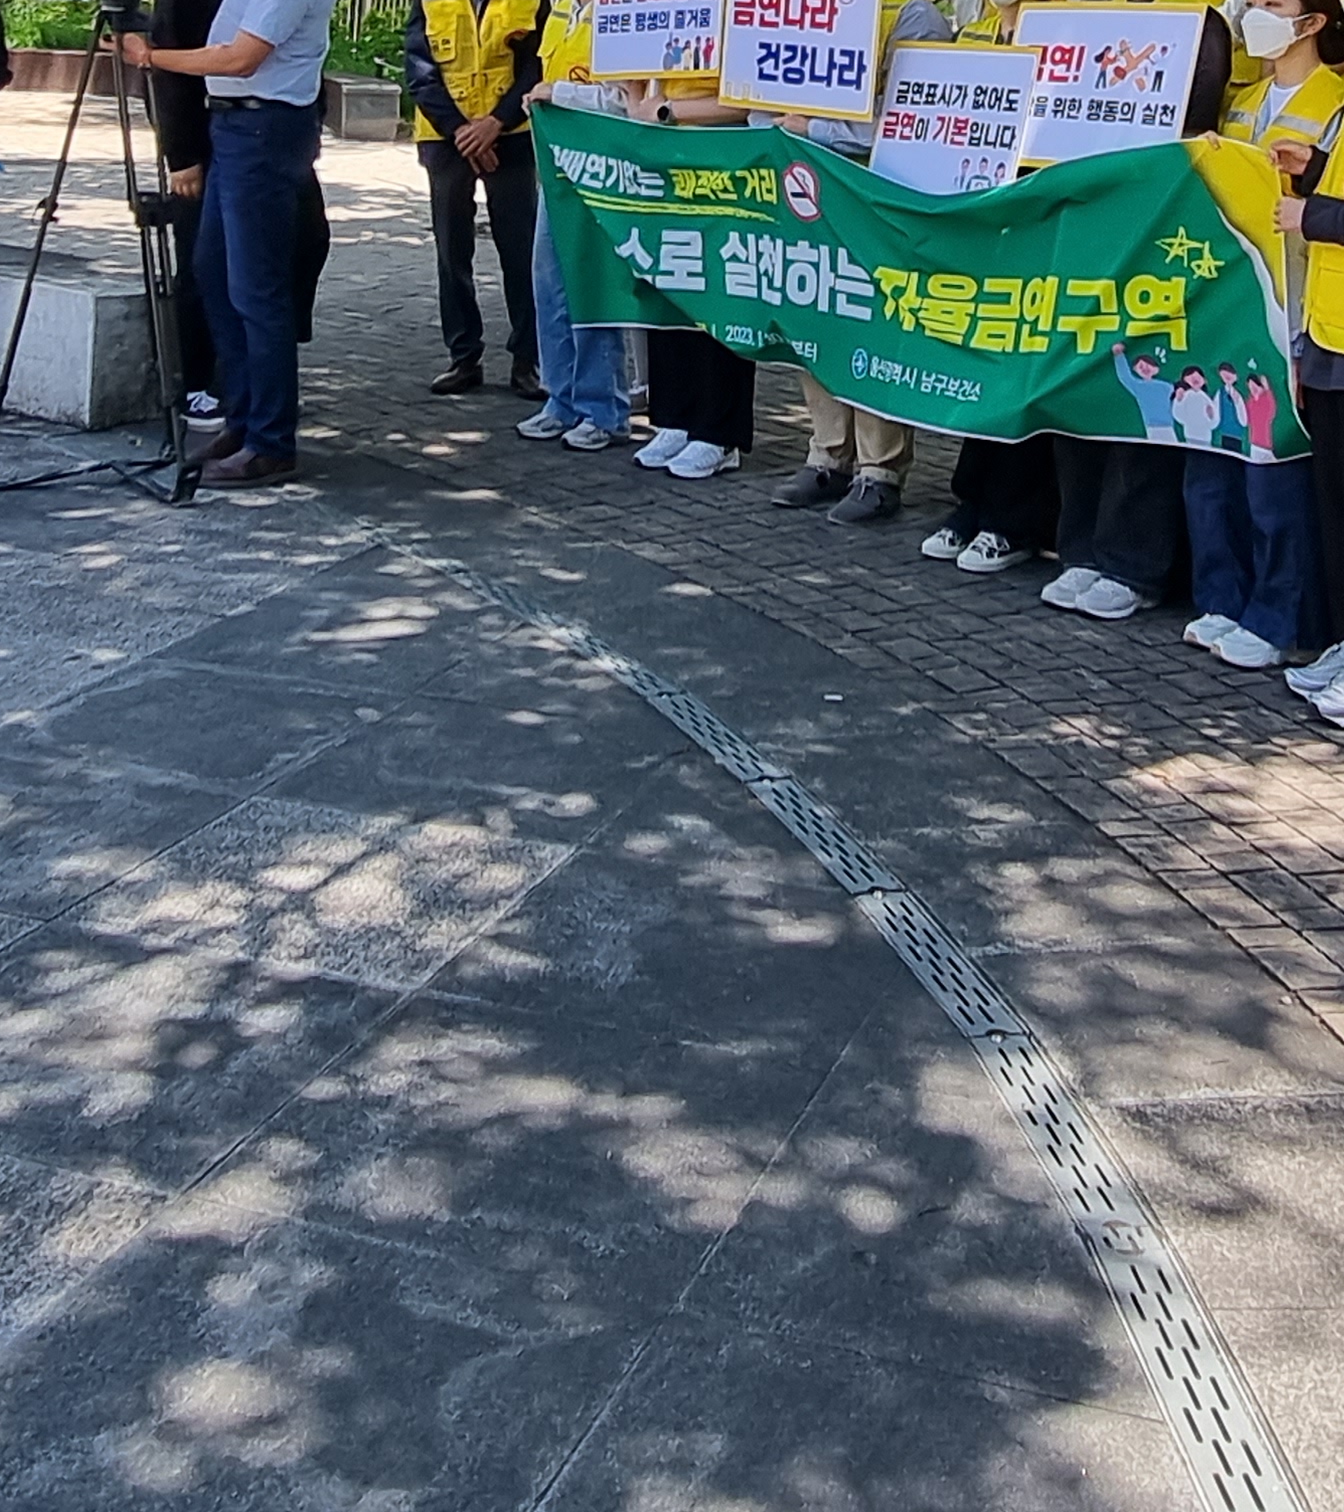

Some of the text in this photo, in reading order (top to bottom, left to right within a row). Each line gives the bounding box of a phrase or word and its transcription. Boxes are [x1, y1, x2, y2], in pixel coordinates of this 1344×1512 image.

[598, 8, 712, 34] 금연은 평생의 즐거움
[756, 41, 867, 91] 건강나라
[895, 81, 1022, 113] 금연표시가 없어도
[1030, 95, 1178, 127] 을 위한 행동의 실천
[882, 111, 1018, 151] 금연이 기본입니다.
[735, 168, 778, 205] 거리
[614, 226, 1188, 354] 스로 실천하는 자율금연구역
[920, 371, 982, 402] 남구보건소
